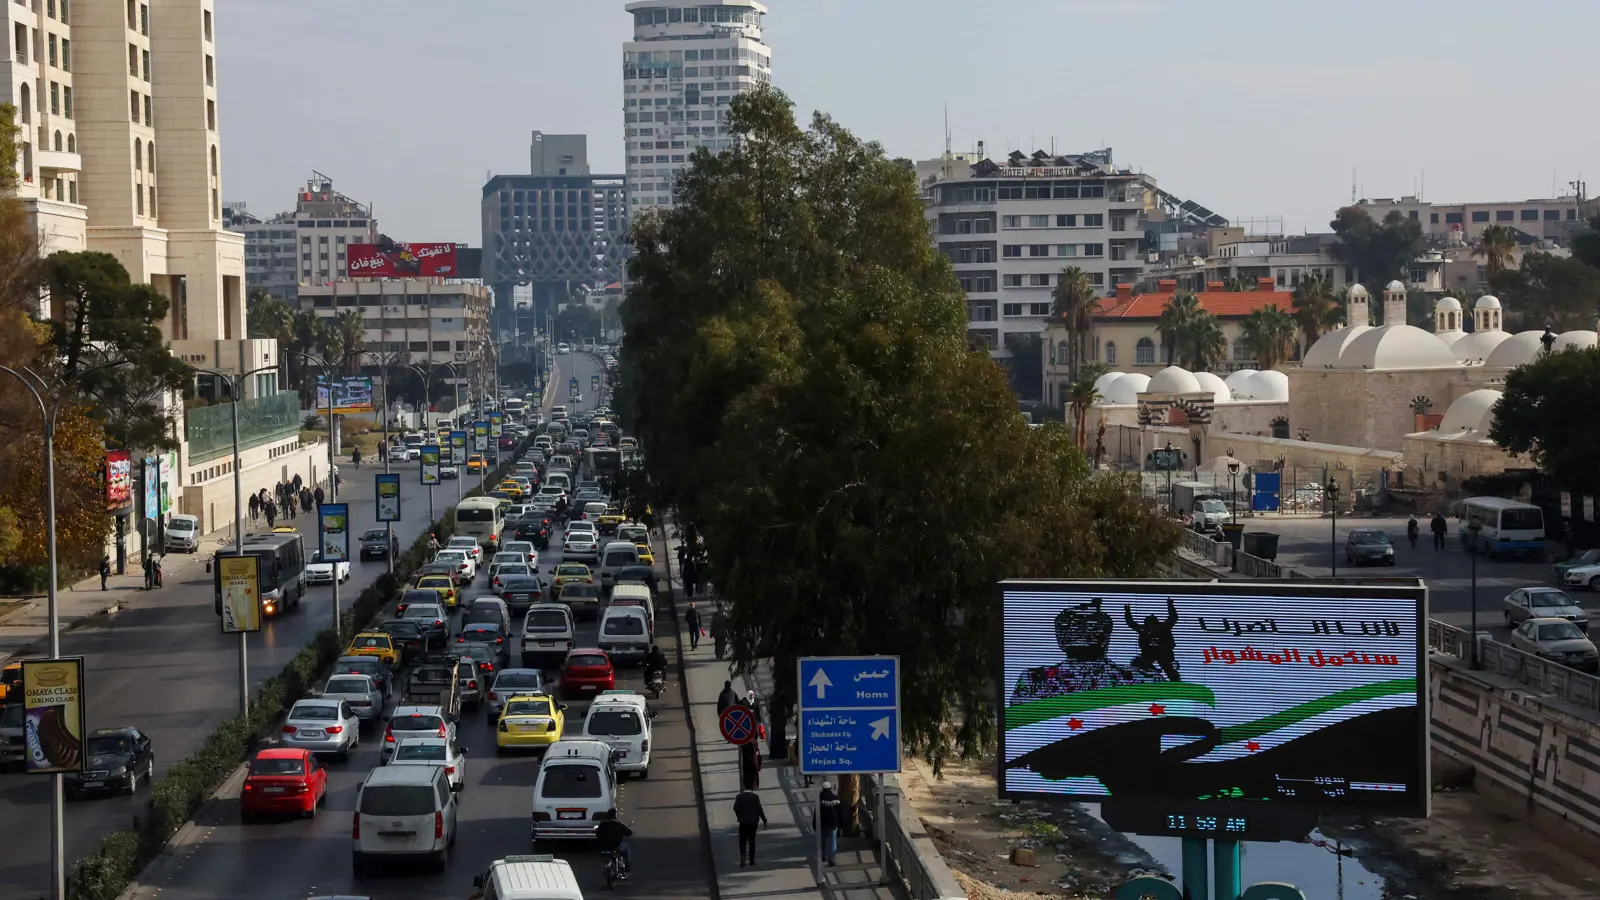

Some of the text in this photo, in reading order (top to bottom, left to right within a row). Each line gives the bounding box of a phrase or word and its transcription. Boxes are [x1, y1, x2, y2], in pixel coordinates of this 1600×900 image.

[1002, 167, 1027, 177] HOTEL
[444, 244, 450, 253] لا
[351, 257, 369, 270] فان
[1202, 645, 1399, 668] سنكمل المشوار
[853, 668, 889, 682] حمص
[26, 688, 52, 696] OMAYA
[808, 715, 856, 727] ساحة الشهداء
[808, 742, 857, 754] ساحة الحجاز
[1168, 815, 1187, 829] 11
[1225, 818, 1246, 832] AM
